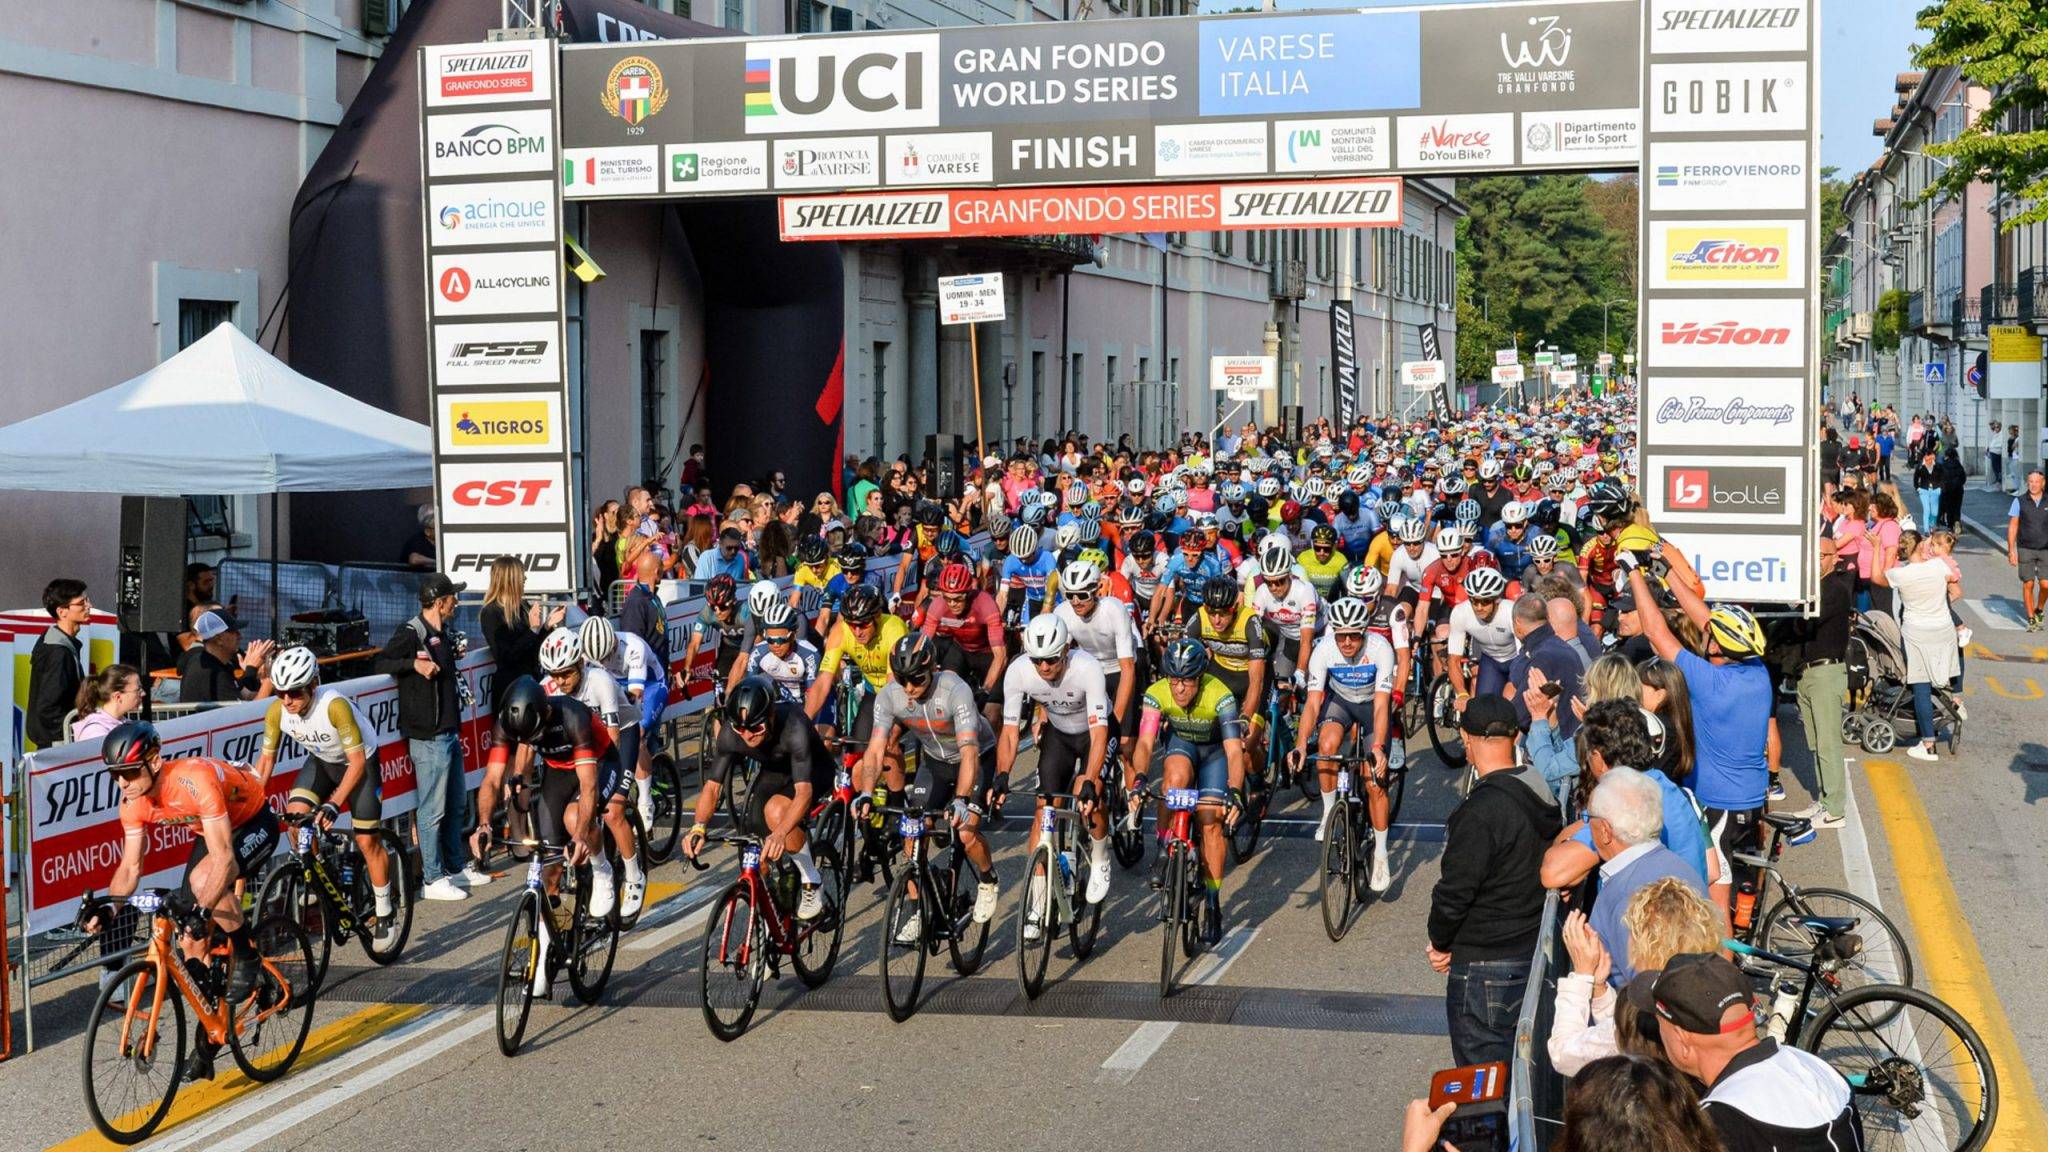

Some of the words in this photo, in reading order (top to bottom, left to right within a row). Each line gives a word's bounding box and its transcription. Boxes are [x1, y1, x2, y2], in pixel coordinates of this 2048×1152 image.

[1657, 8, 1800, 31] SPECIALIZED
[1218, 33, 1335, 62] VARESE
[445, 54, 529, 73] SPECIALIZED
[953, 48, 1042, 75] GRAN
[1051, 40, 1166, 70] FONDO
[778, 52, 923, 116] UCI
[1221, 69, 1310, 97] ITALIA
[1497, 73, 1512, 82] TRE
[1514, 72, 1536, 82] VALLI
[1538, 70, 1575, 82] VARESINE
[446, 80, 499, 92] GRANFONDO
[500, 78, 528, 88] SERIES
[953, 79, 1067, 108] WORLD
[1073, 74, 1178, 103] SERIES
[1497, 81, 1575, 94] GRANFONDO
[1663, 79, 1778, 114] GOBIK
[626, 127, 645, 136] 1929
[1420, 120, 1490, 148] #Varese
[1564, 122, 1637, 133] Dipartimento
[435, 138, 502, 158] BANCO
[507, 136, 545, 155] BPM
[1564, 136, 1582, 146] per
[1585, 134, 1595, 143] lo
[1598, 133, 1628, 145] Sport
[926, 152, 967, 163] COMUNE
[970, 152, 980, 161] DI
[1011, 135, 1138, 170] FINISH
[600, 159, 643, 168] MINISTERO
[600, 167, 616, 175] DEL
[617, 165, 653, 174] TURISMO
[701, 156, 748, 168] Regione
[927, 162, 979, 174] VARESE
[1683, 164, 1801, 177] FERROVIENORD
[701, 166, 761, 177] Lombardia
[465, 198, 546, 220] acinque
[791, 201, 943, 228] SPECIALIZED
[954, 196, 1126, 225] GRANFONDO
[1132, 193, 1215, 221] SERIES
[1229, 188, 1392, 217] SPECIALIZED
[465, 221, 497, 230] ENERGIA
[499, 221, 516, 229] CHE
[517, 220, 546, 228] UNISCE
[475, 276, 550, 289] ALL4CYCLING
[946, 291, 973, 300] UOMINI
[979, 289, 996, 297] MEN
[960, 300, 969, 308] 19
[1662, 321, 1790, 345] Vision
[1996, 327, 2022, 335] FERMATA
[1227, 375, 1260, 386] 25MT
[1657, 397, 1684, 424] Ciclo
[1682, 396, 1723, 423] Promo
[1722, 397, 1794, 427] Components
[482, 420, 543, 435] TIGROS
[452, 480, 553, 507] CST
[1713, 484, 1780, 505] bollé
[1695, 554, 1786, 582] LereTi
[169, 950, 214, 1016] PINARELLO
